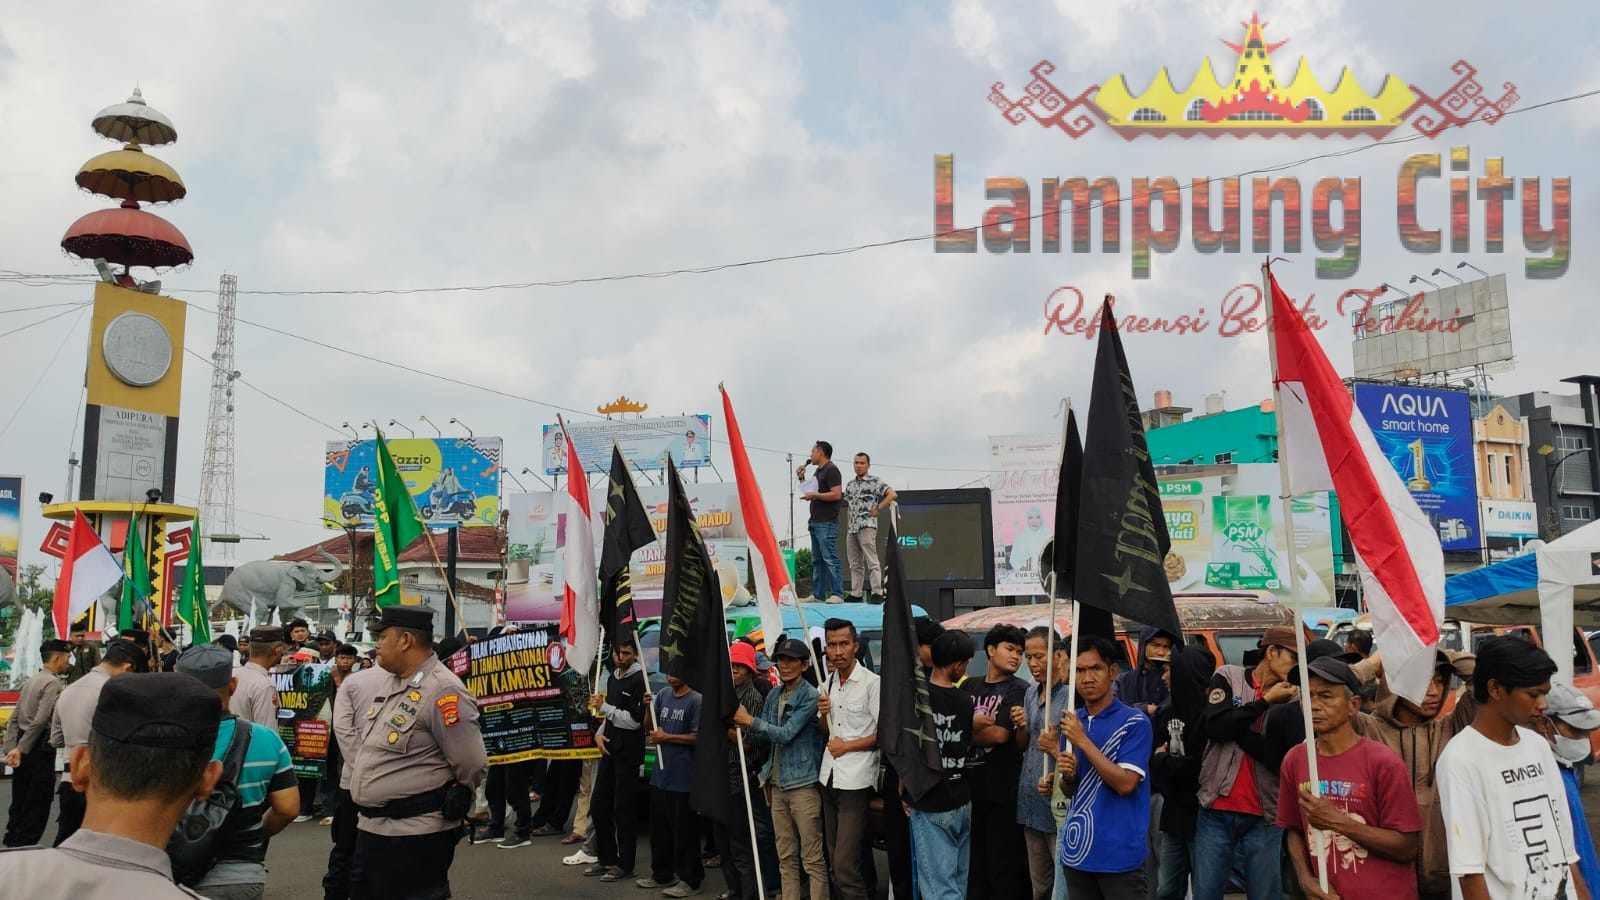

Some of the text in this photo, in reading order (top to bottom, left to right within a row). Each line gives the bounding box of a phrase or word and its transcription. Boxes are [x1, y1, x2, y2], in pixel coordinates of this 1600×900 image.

[1381, 393, 1448, 418] AQUA
[1382, 420, 1449, 433] smart home
[1167, 484, 1191, 493] PSM
[697, 511, 733, 529] MADU
[1498, 511, 1532, 521] DAIKIN
[1228, 525, 1259, 538] PSM
[479, 654, 504, 675] TAMAN
[467, 675, 488, 697] WAY
[490, 666, 552, 694] KAMBAS!
